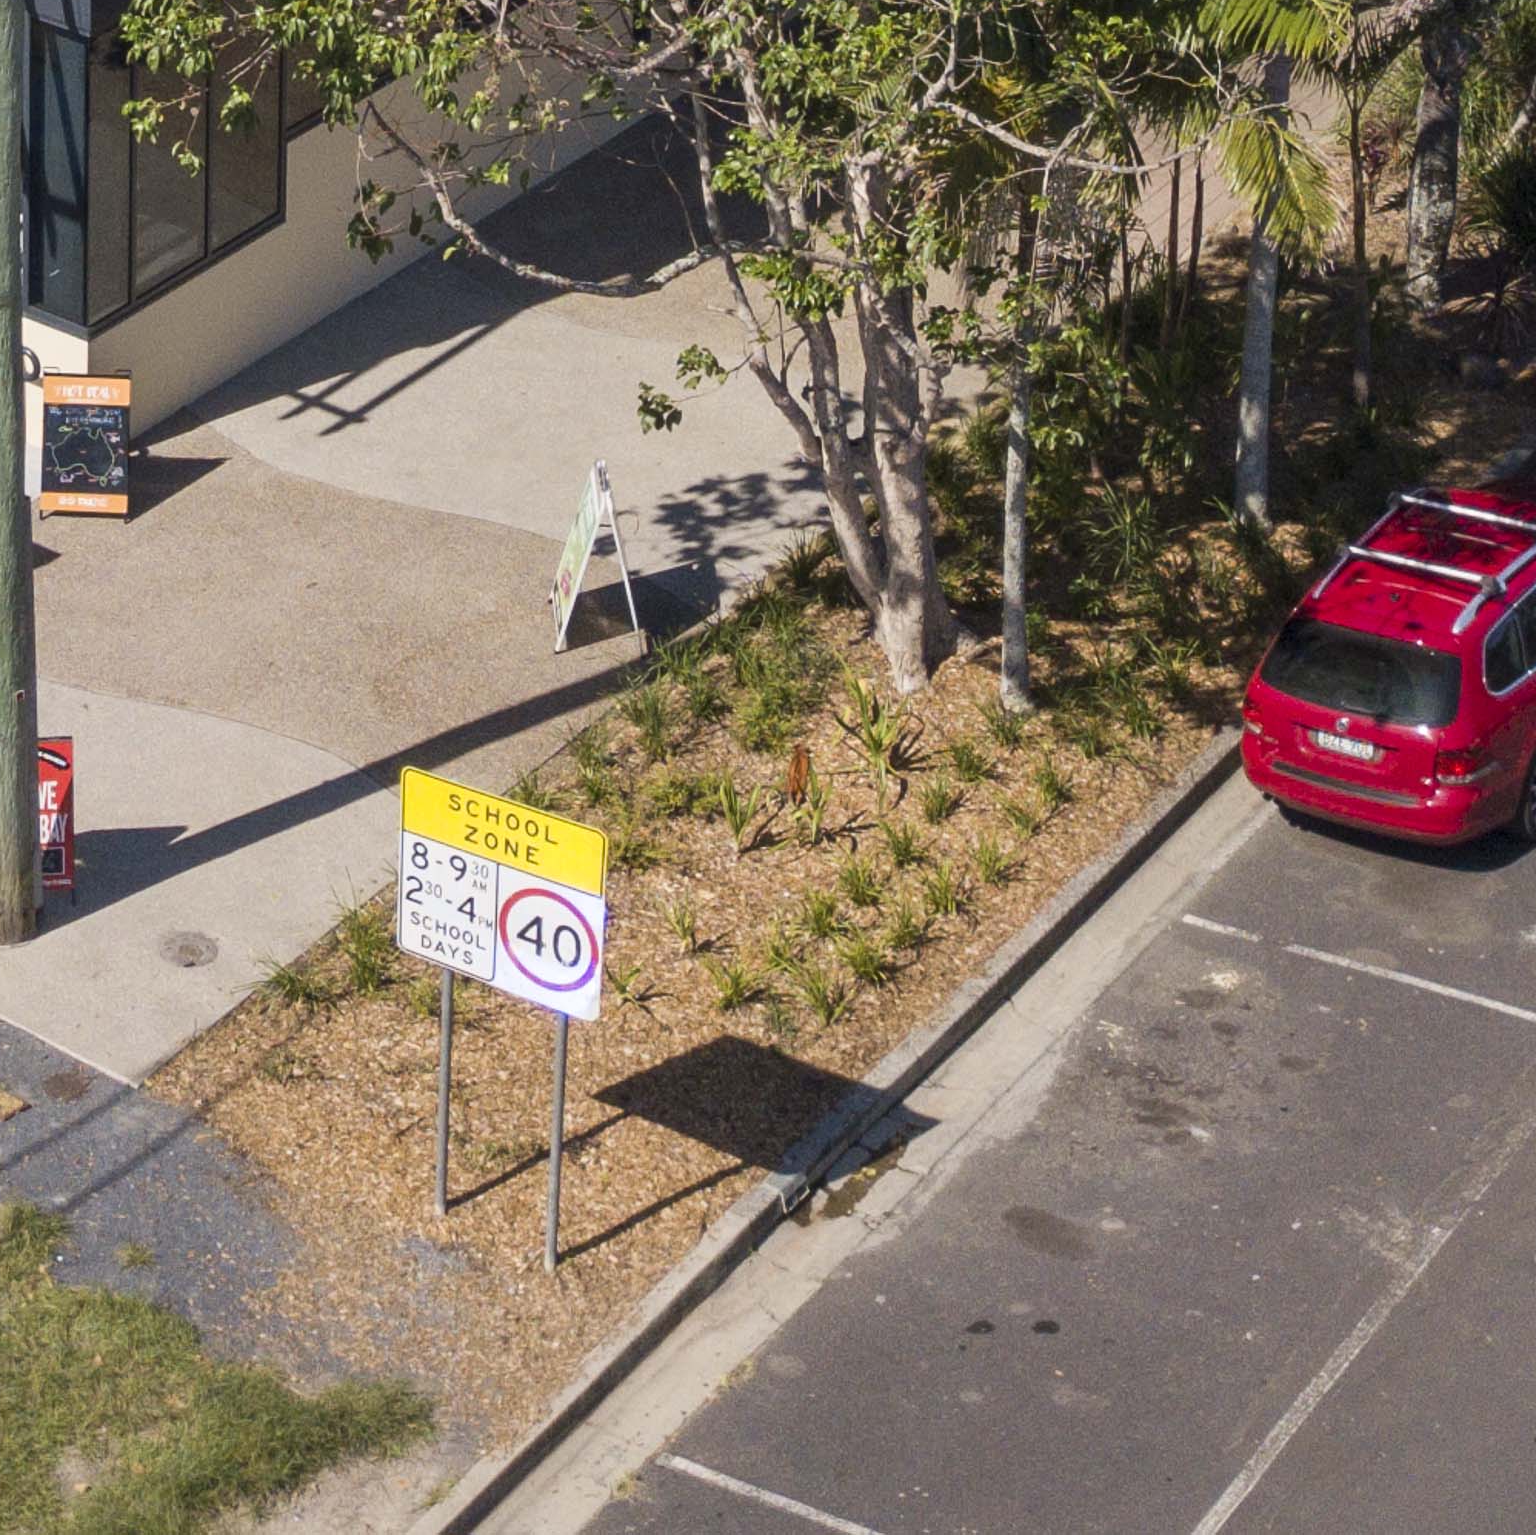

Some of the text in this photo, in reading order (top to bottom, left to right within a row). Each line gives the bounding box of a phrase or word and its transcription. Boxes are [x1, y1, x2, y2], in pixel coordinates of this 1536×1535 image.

[40, 812, 68, 844] BAY
[448, 793, 559, 846] SCHOOL
[464, 824, 541, 866] ZONE
[471, 878, 488, 893] AM
[410, 911, 487, 951] SCHOOL
[420, 934, 474, 966] DAYS
[516, 915, 582, 968] 40
